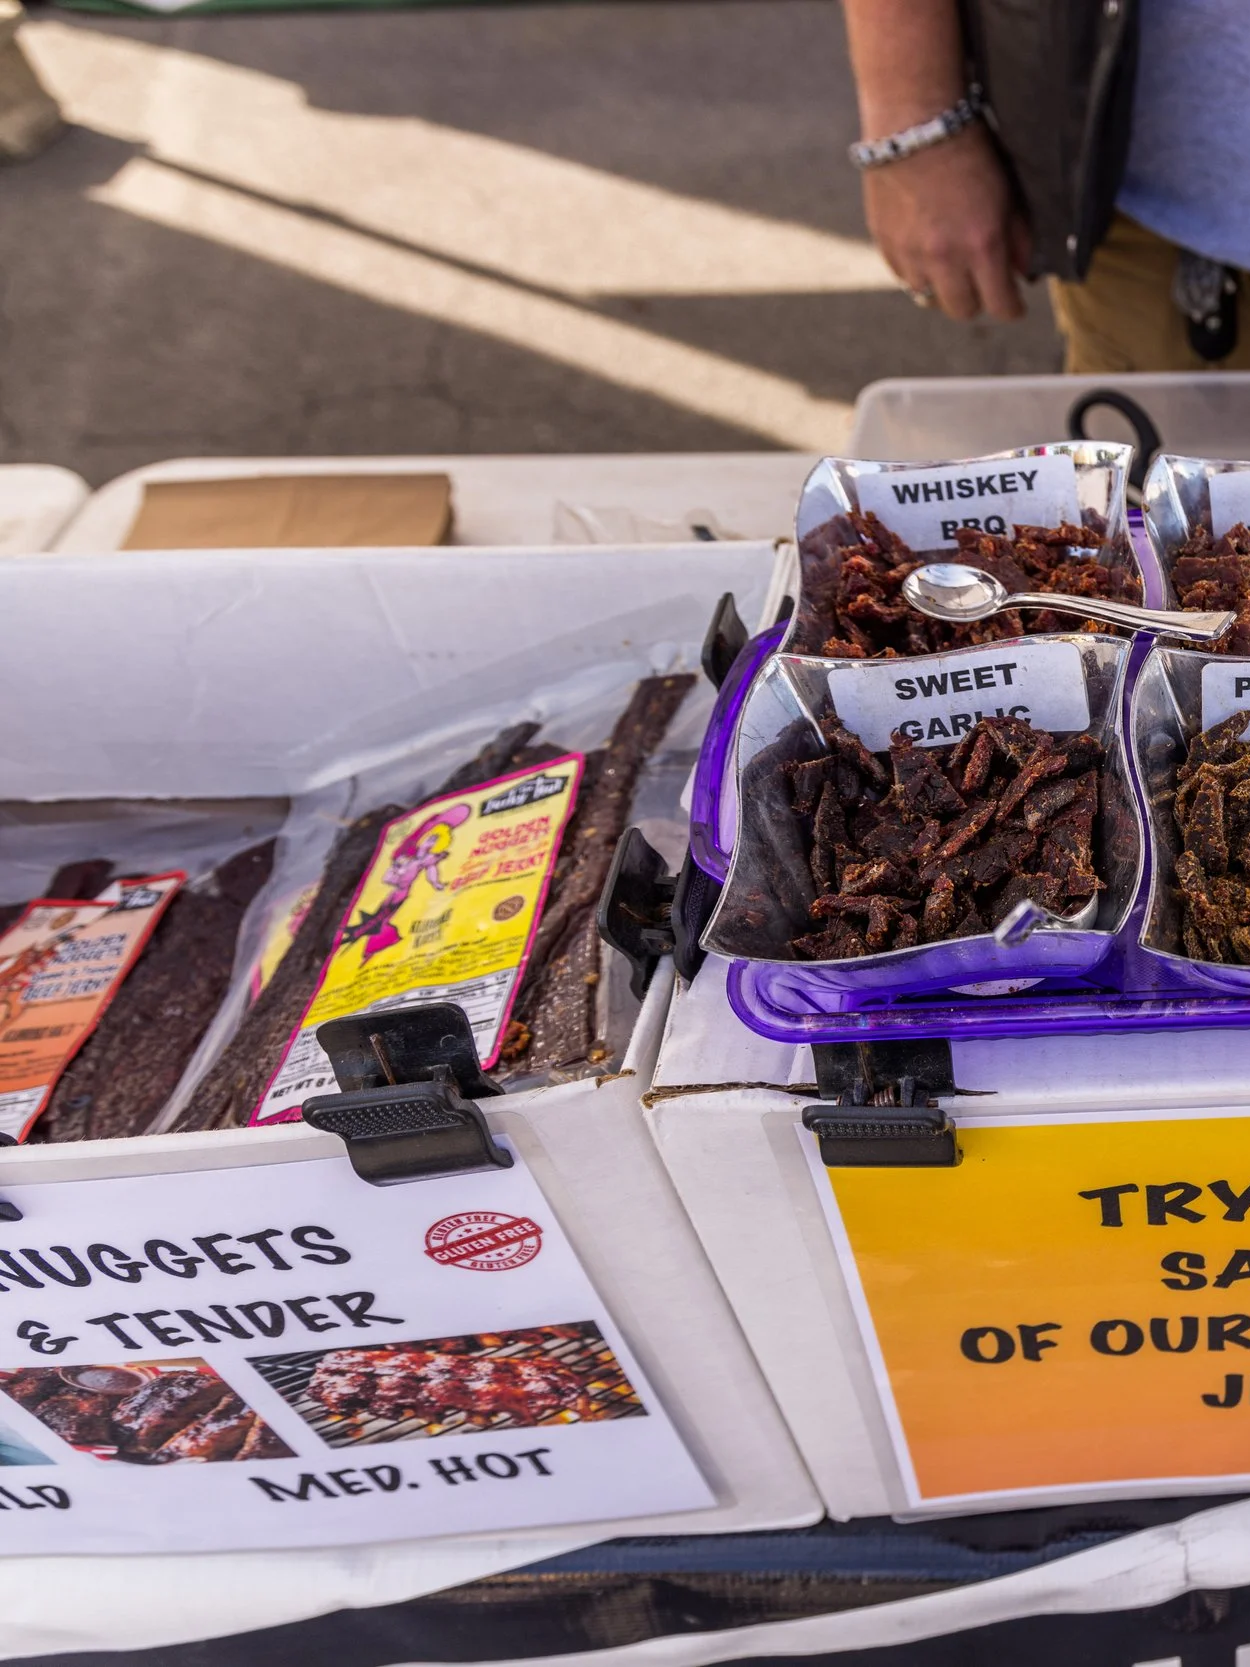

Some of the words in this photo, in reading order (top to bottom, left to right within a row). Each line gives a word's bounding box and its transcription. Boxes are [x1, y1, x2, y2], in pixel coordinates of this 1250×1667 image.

[892, 469, 1039, 504] WHISKEY
[894, 663, 1018, 700] SWEET
[431, 1217, 464, 1241] GLUTEN
[466, 1215, 497, 1223] FREE
[432, 1236, 496, 1261] GLUTEN
[494, 1221, 536, 1242] FREE
[0, 1225, 352, 1293] NUGGETS
[470, 1257, 517, 1270] GLUTEN
[517, 1244, 535, 1264] FREE
[16, 1319, 80, 1355] &
[86, 1290, 405, 1351] TENDER
[960, 1322, 1064, 1365] OF
[0, 1484, 70, 1510] LD
[248, 1463, 419, 1504] MED.
[428, 1448, 555, 1488] HOT
